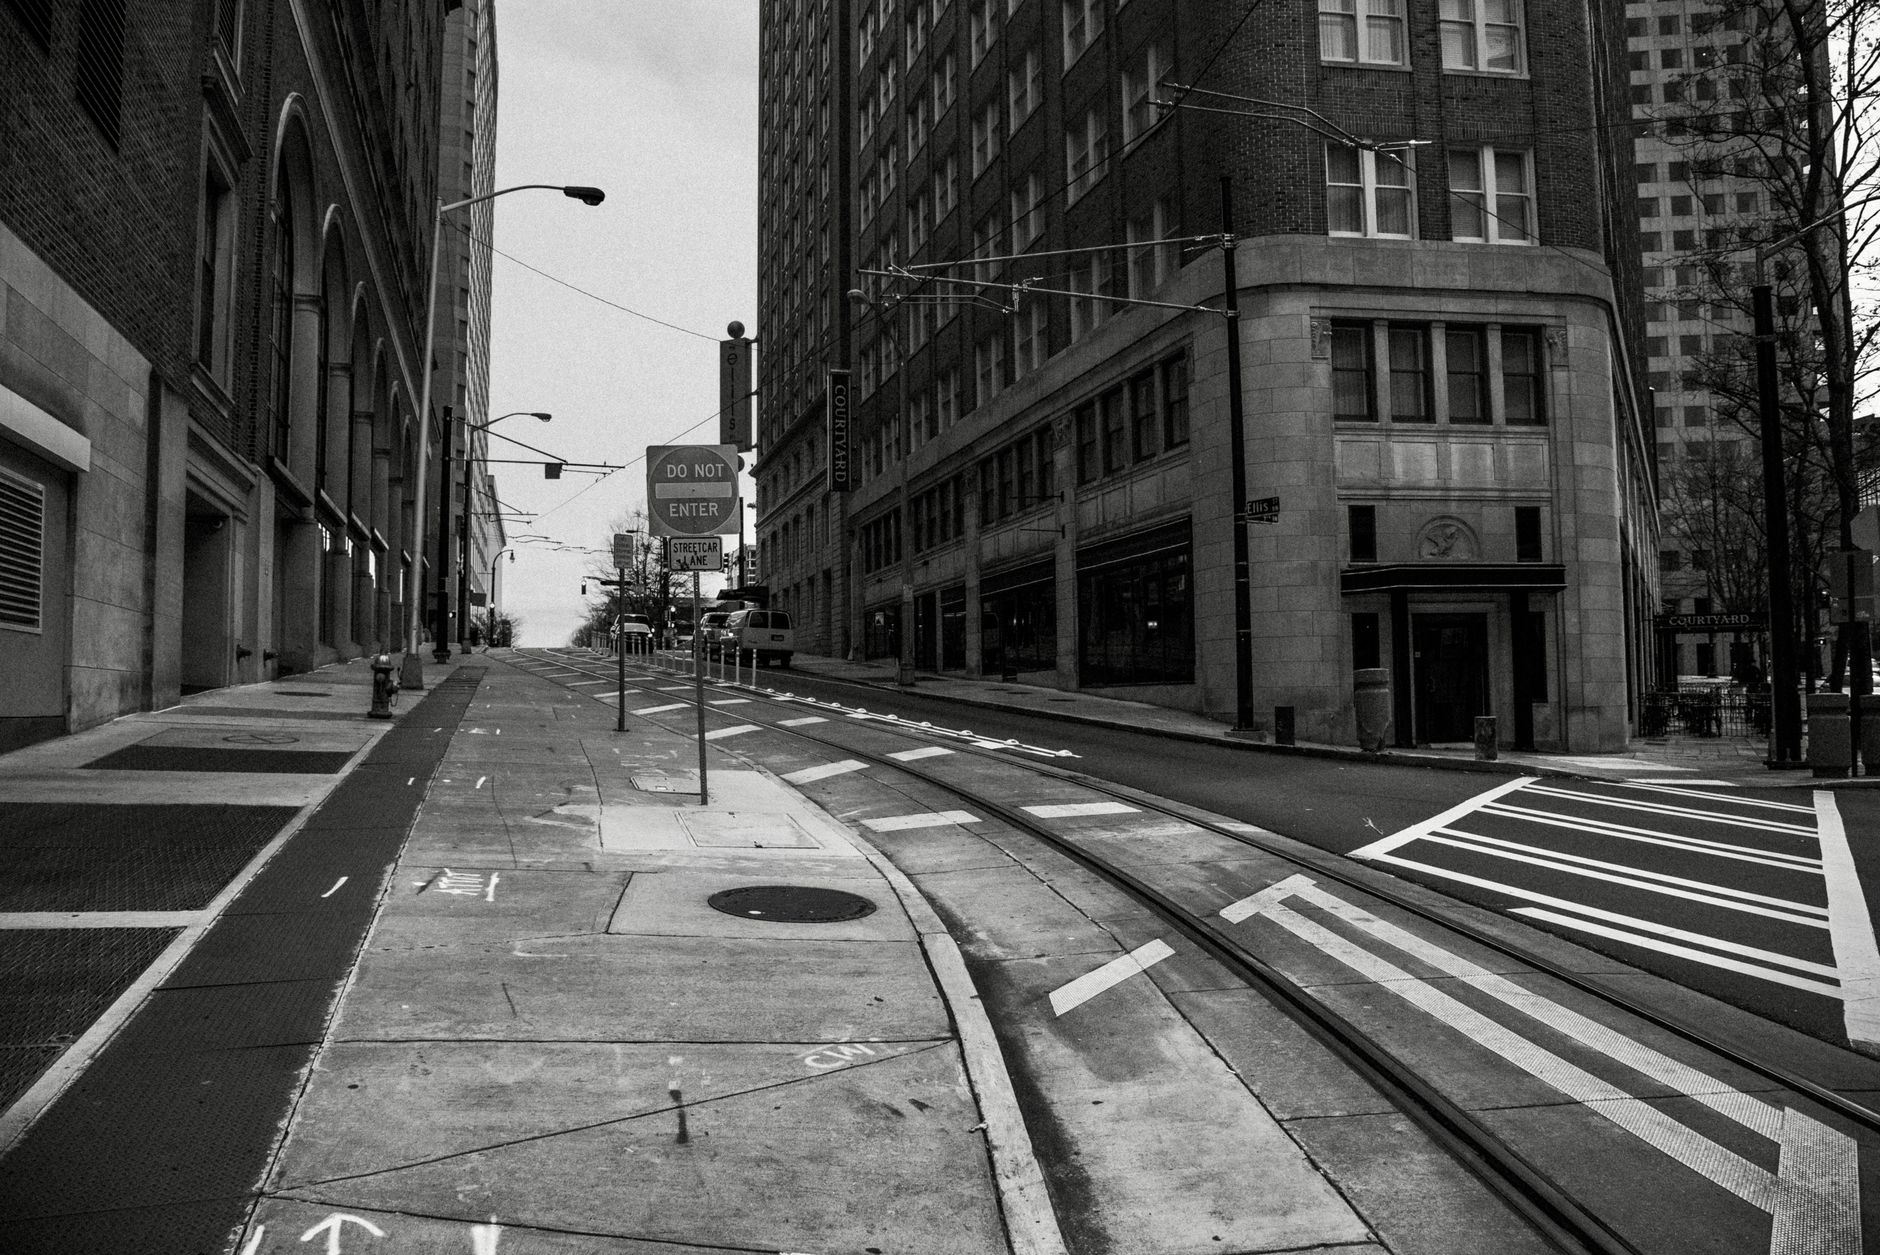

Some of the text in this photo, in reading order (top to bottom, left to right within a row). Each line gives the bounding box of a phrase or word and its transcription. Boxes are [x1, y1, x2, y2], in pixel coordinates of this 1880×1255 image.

[834, 384, 847, 482] COURTYARD
[666, 463, 724, 478] DO NOT
[669, 503, 719, 517] ENTER
[1247, 502, 1269, 514] Ellis
[673, 542, 718, 554] STREETCAR
[683, 555, 708, 566] LANE
[1669, 614, 1750, 626] COURTYARD
